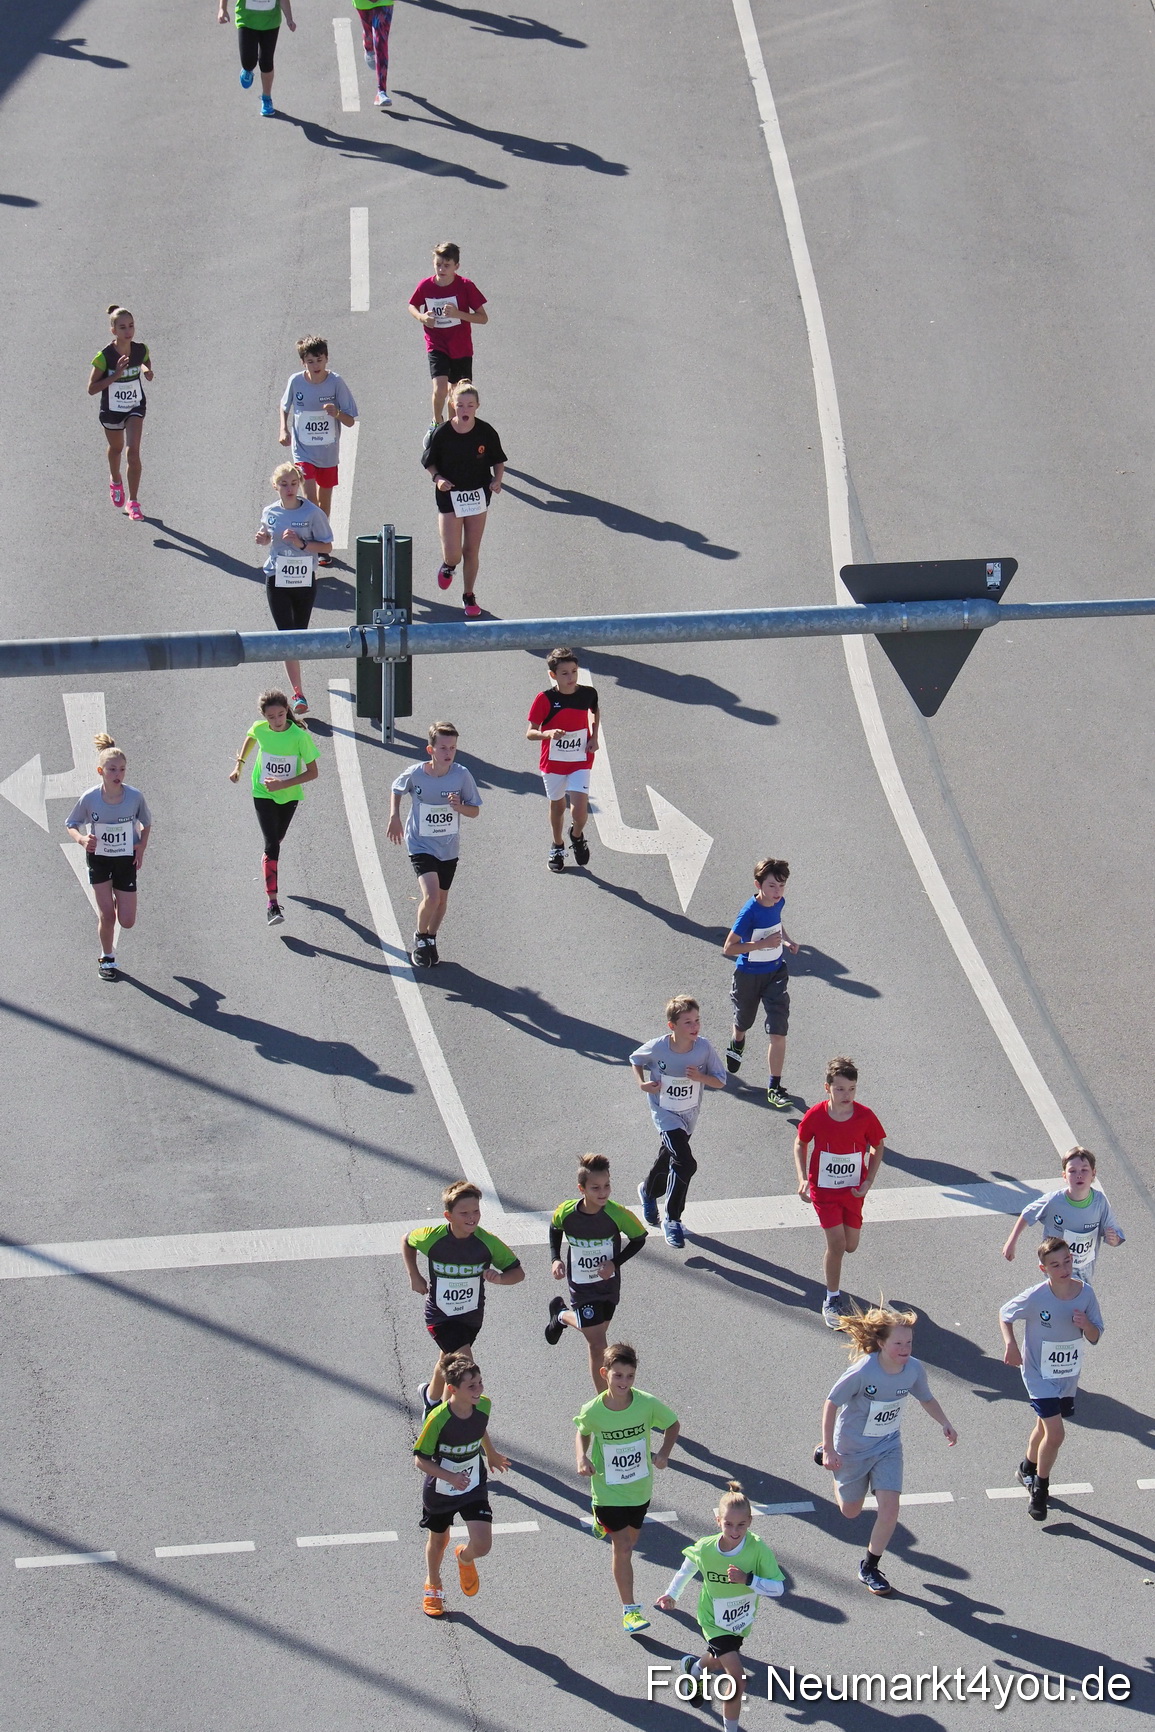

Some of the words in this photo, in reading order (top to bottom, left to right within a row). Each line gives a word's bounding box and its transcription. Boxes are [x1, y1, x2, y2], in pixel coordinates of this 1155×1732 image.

[114, 390, 138, 400] 4024
[305, 421, 330, 432] 4032
[456, 490, 481, 502] 4049
[282, 565, 308, 575] 4010
[556, 738, 582, 750] 4044
[266, 762, 291, 774] 4050
[426, 813, 453, 824] 4036
[101, 832, 126, 844] 4011
[666, 1084, 694, 1097] 4051
[826, 1163, 856, 1174] 4000
[432, 1260, 486, 1276] BOCK
[443, 1288, 474, 1301] 4029
[1048, 1349, 1078, 1363] 4014
[601, 1424, 646, 1440] BOCK
[612, 1452, 642, 1468] 4028
[722, 1600, 750, 1622] 4025
